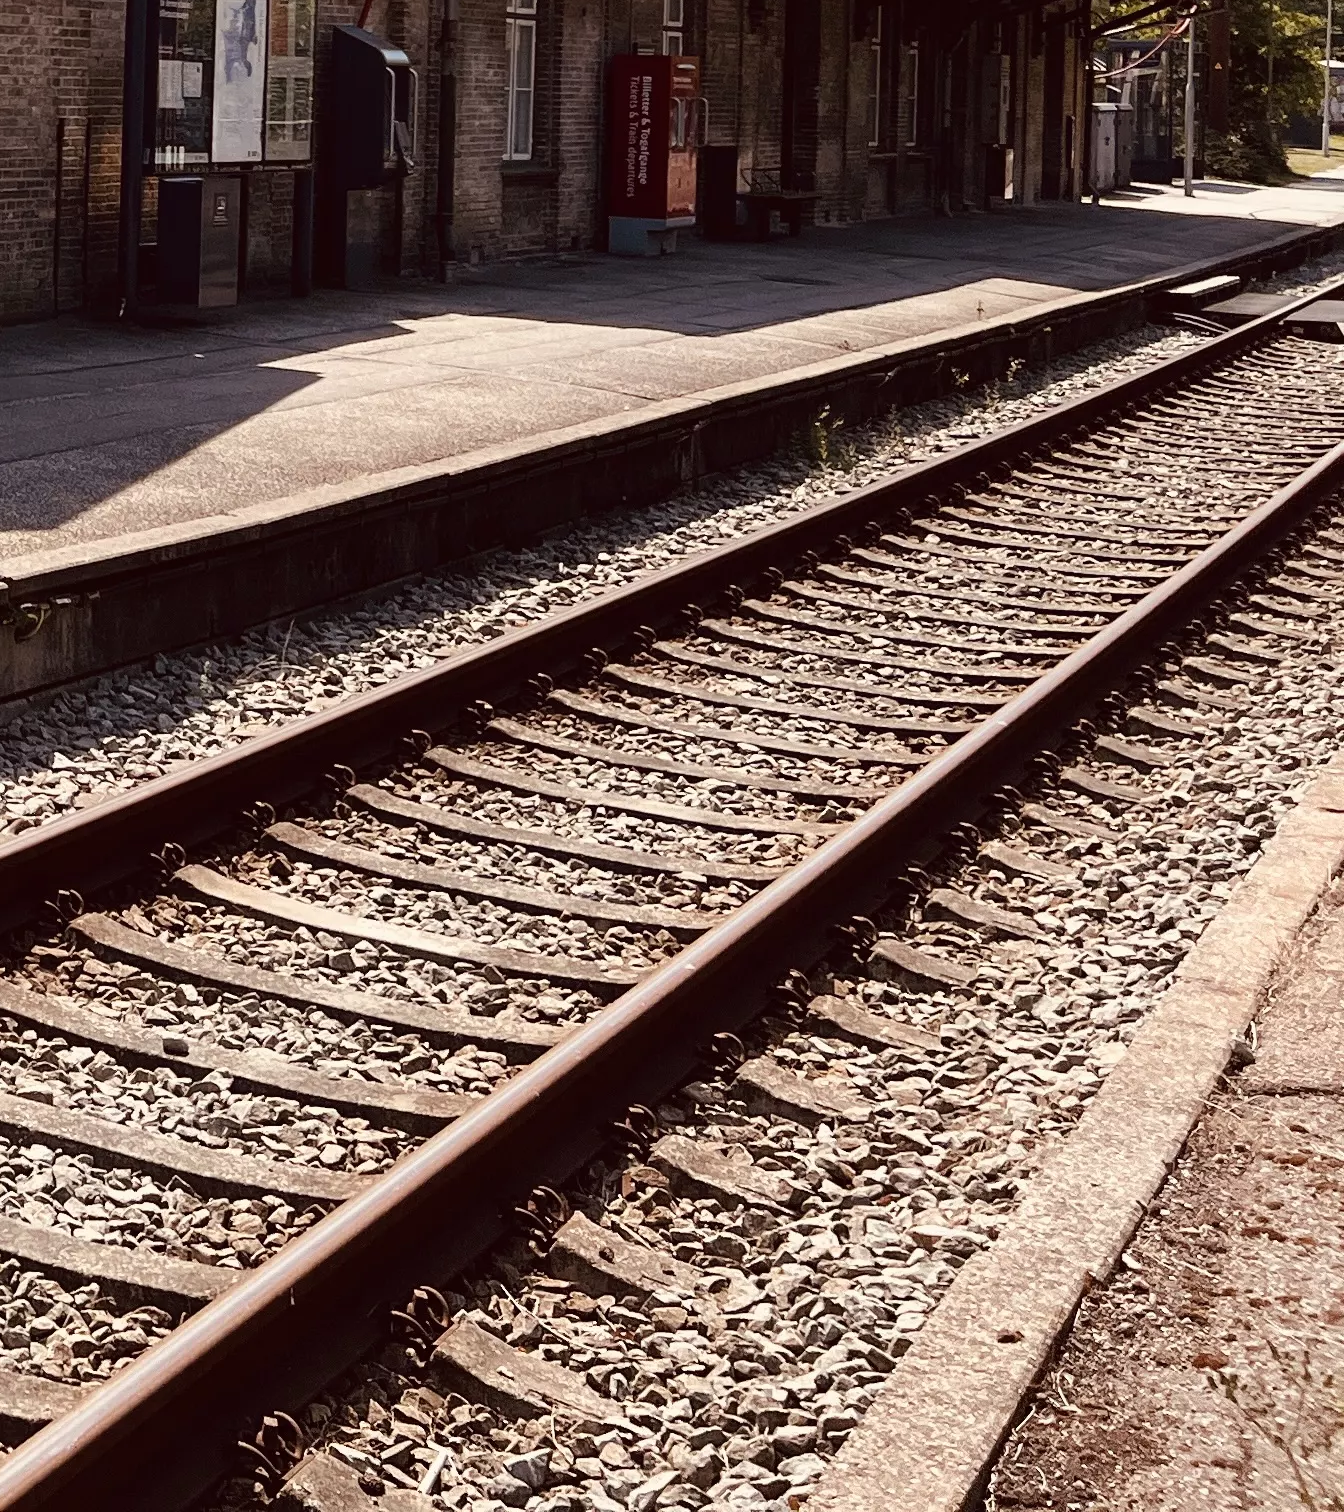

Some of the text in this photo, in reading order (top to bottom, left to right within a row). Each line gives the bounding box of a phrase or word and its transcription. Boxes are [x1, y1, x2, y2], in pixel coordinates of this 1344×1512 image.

[629, 76, 640, 109] Tickets
[642, 76, 652, 115] Billetter
[628, 121, 639, 145] Train
[640, 118, 651, 126] &
[626, 146, 637, 198] departures
